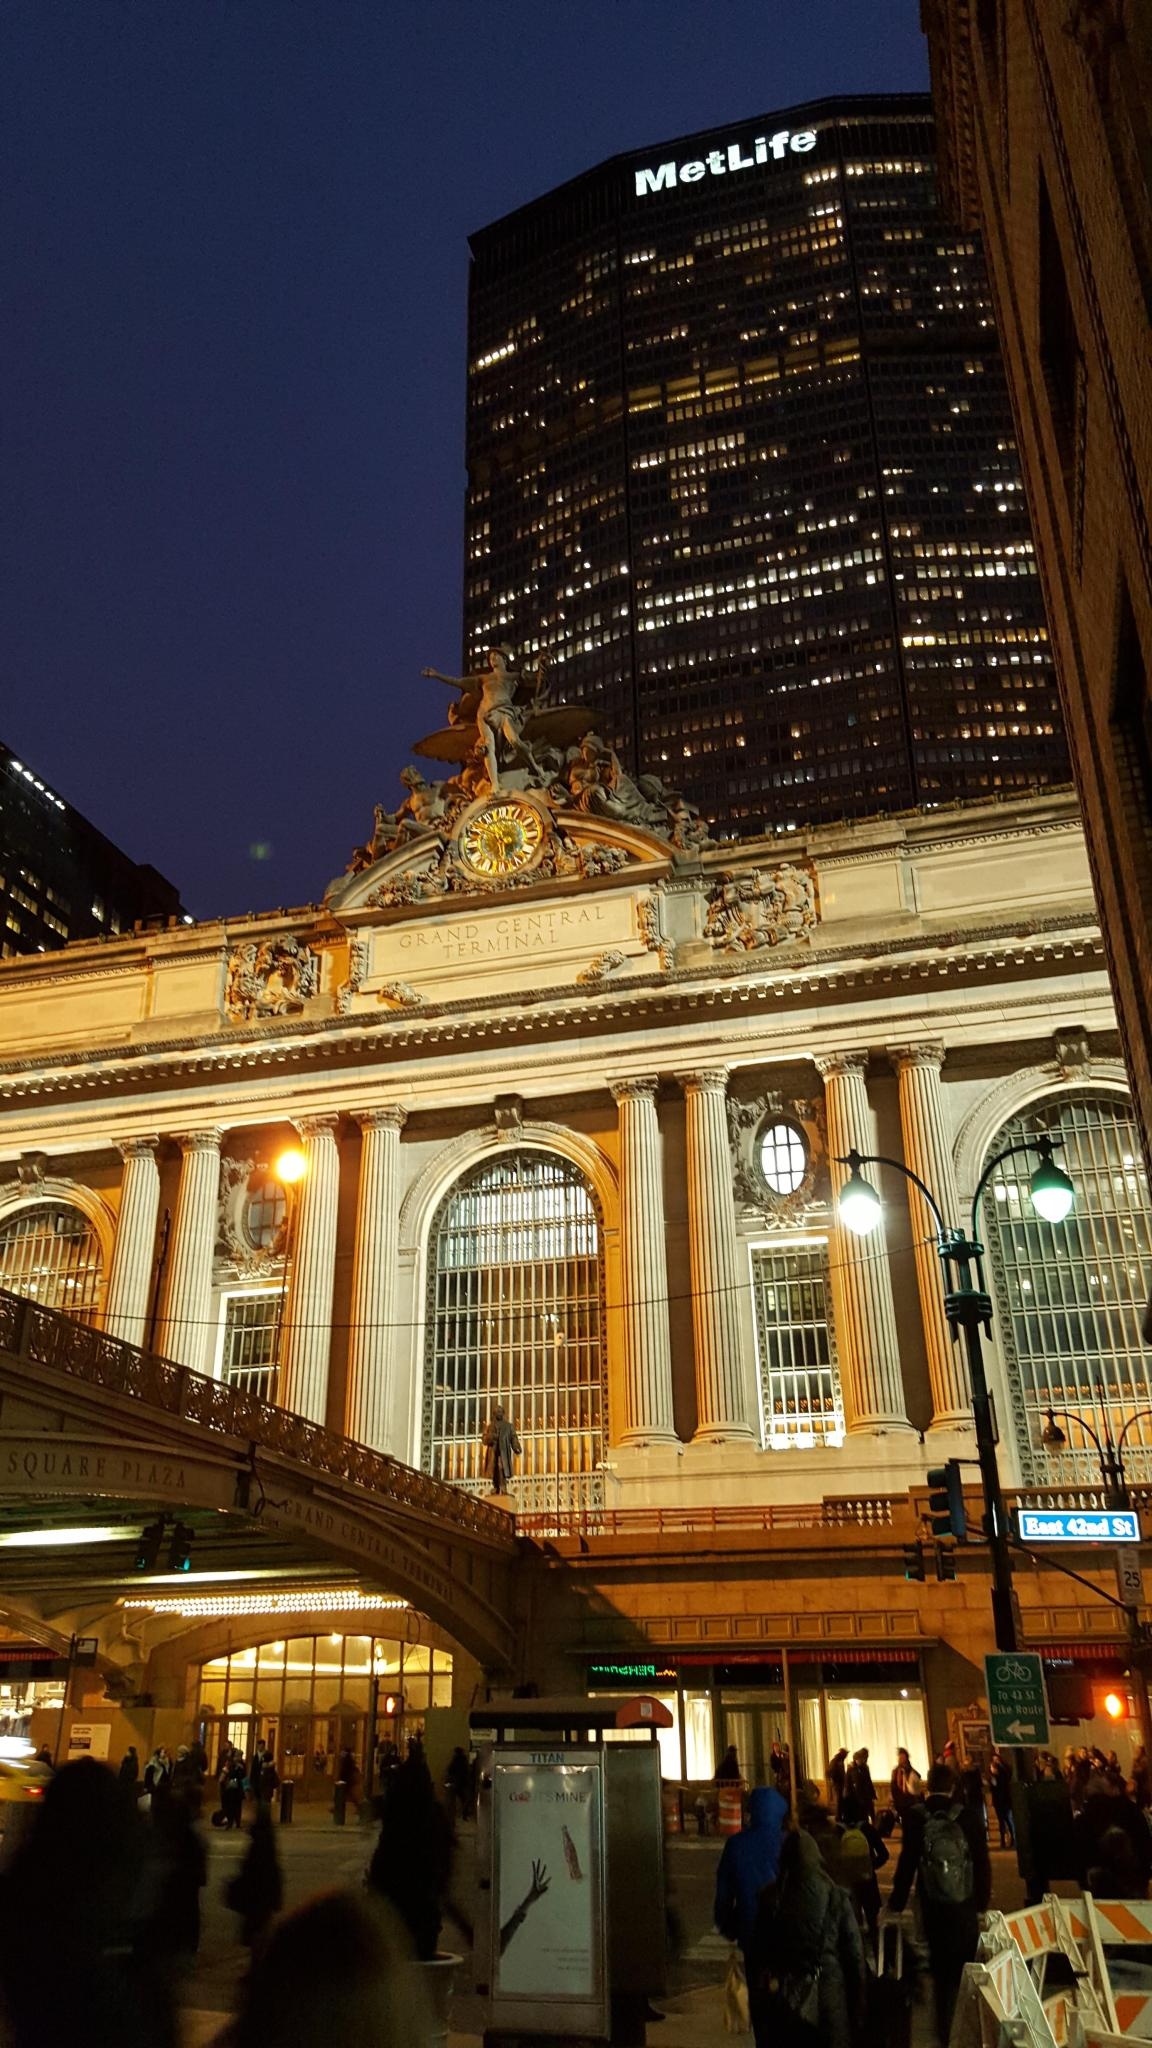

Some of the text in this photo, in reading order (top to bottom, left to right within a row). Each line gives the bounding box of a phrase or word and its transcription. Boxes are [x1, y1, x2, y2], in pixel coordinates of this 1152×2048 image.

[635, 130, 817, 196] MetLife
[399, 906, 605, 948] GRAND CENTRAL
[442, 930, 559, 959] TERMINAL
[7, 1451, 185, 1488] SQUARE PLAZA
[1025, 1517, 1133, 1536] East 42nd St
[1123, 1570, 1140, 1588] 25
[997, 1690, 1008, 1700] To
[1025, 1690, 1035, 1700] St
[992, 1704, 1043, 1715] Bike Route
[530, 1753, 565, 1763] TITAN
[555, 1791, 587, 1803] MINE
